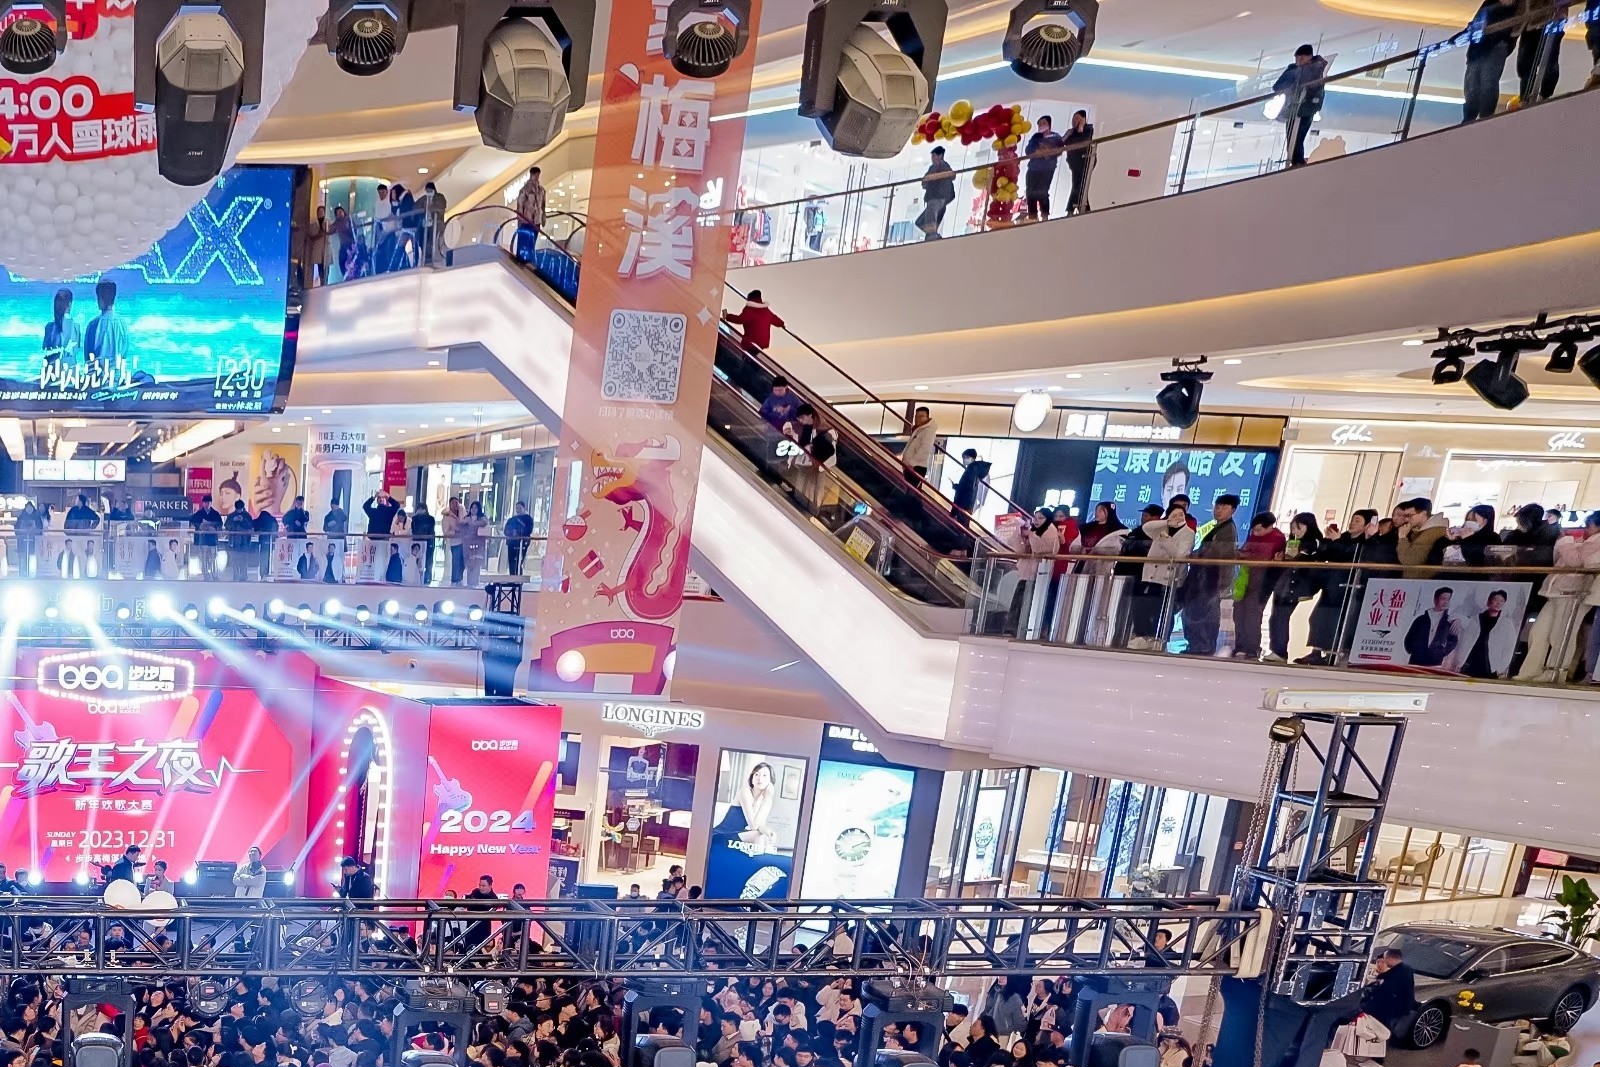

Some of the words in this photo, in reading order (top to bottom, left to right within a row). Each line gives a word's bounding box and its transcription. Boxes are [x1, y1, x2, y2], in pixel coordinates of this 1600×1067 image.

[9, 112, 157, 157] 万人雪球雨
[617, 0, 717, 281] 梅溪
[144, 500, 189, 511] PARKER
[602, 704, 703, 728] LONGINES
[16, 738, 216, 793] 歌王之夜
[75, 799, 153, 811] 新年欢歌大赛
[439, 809, 536, 834] 2024
[78, 830, 175, 848] 2023.12.31
[430, 843, 475, 857] Happy
[477, 844, 506, 855] New
[509, 845, 541, 856] Year
